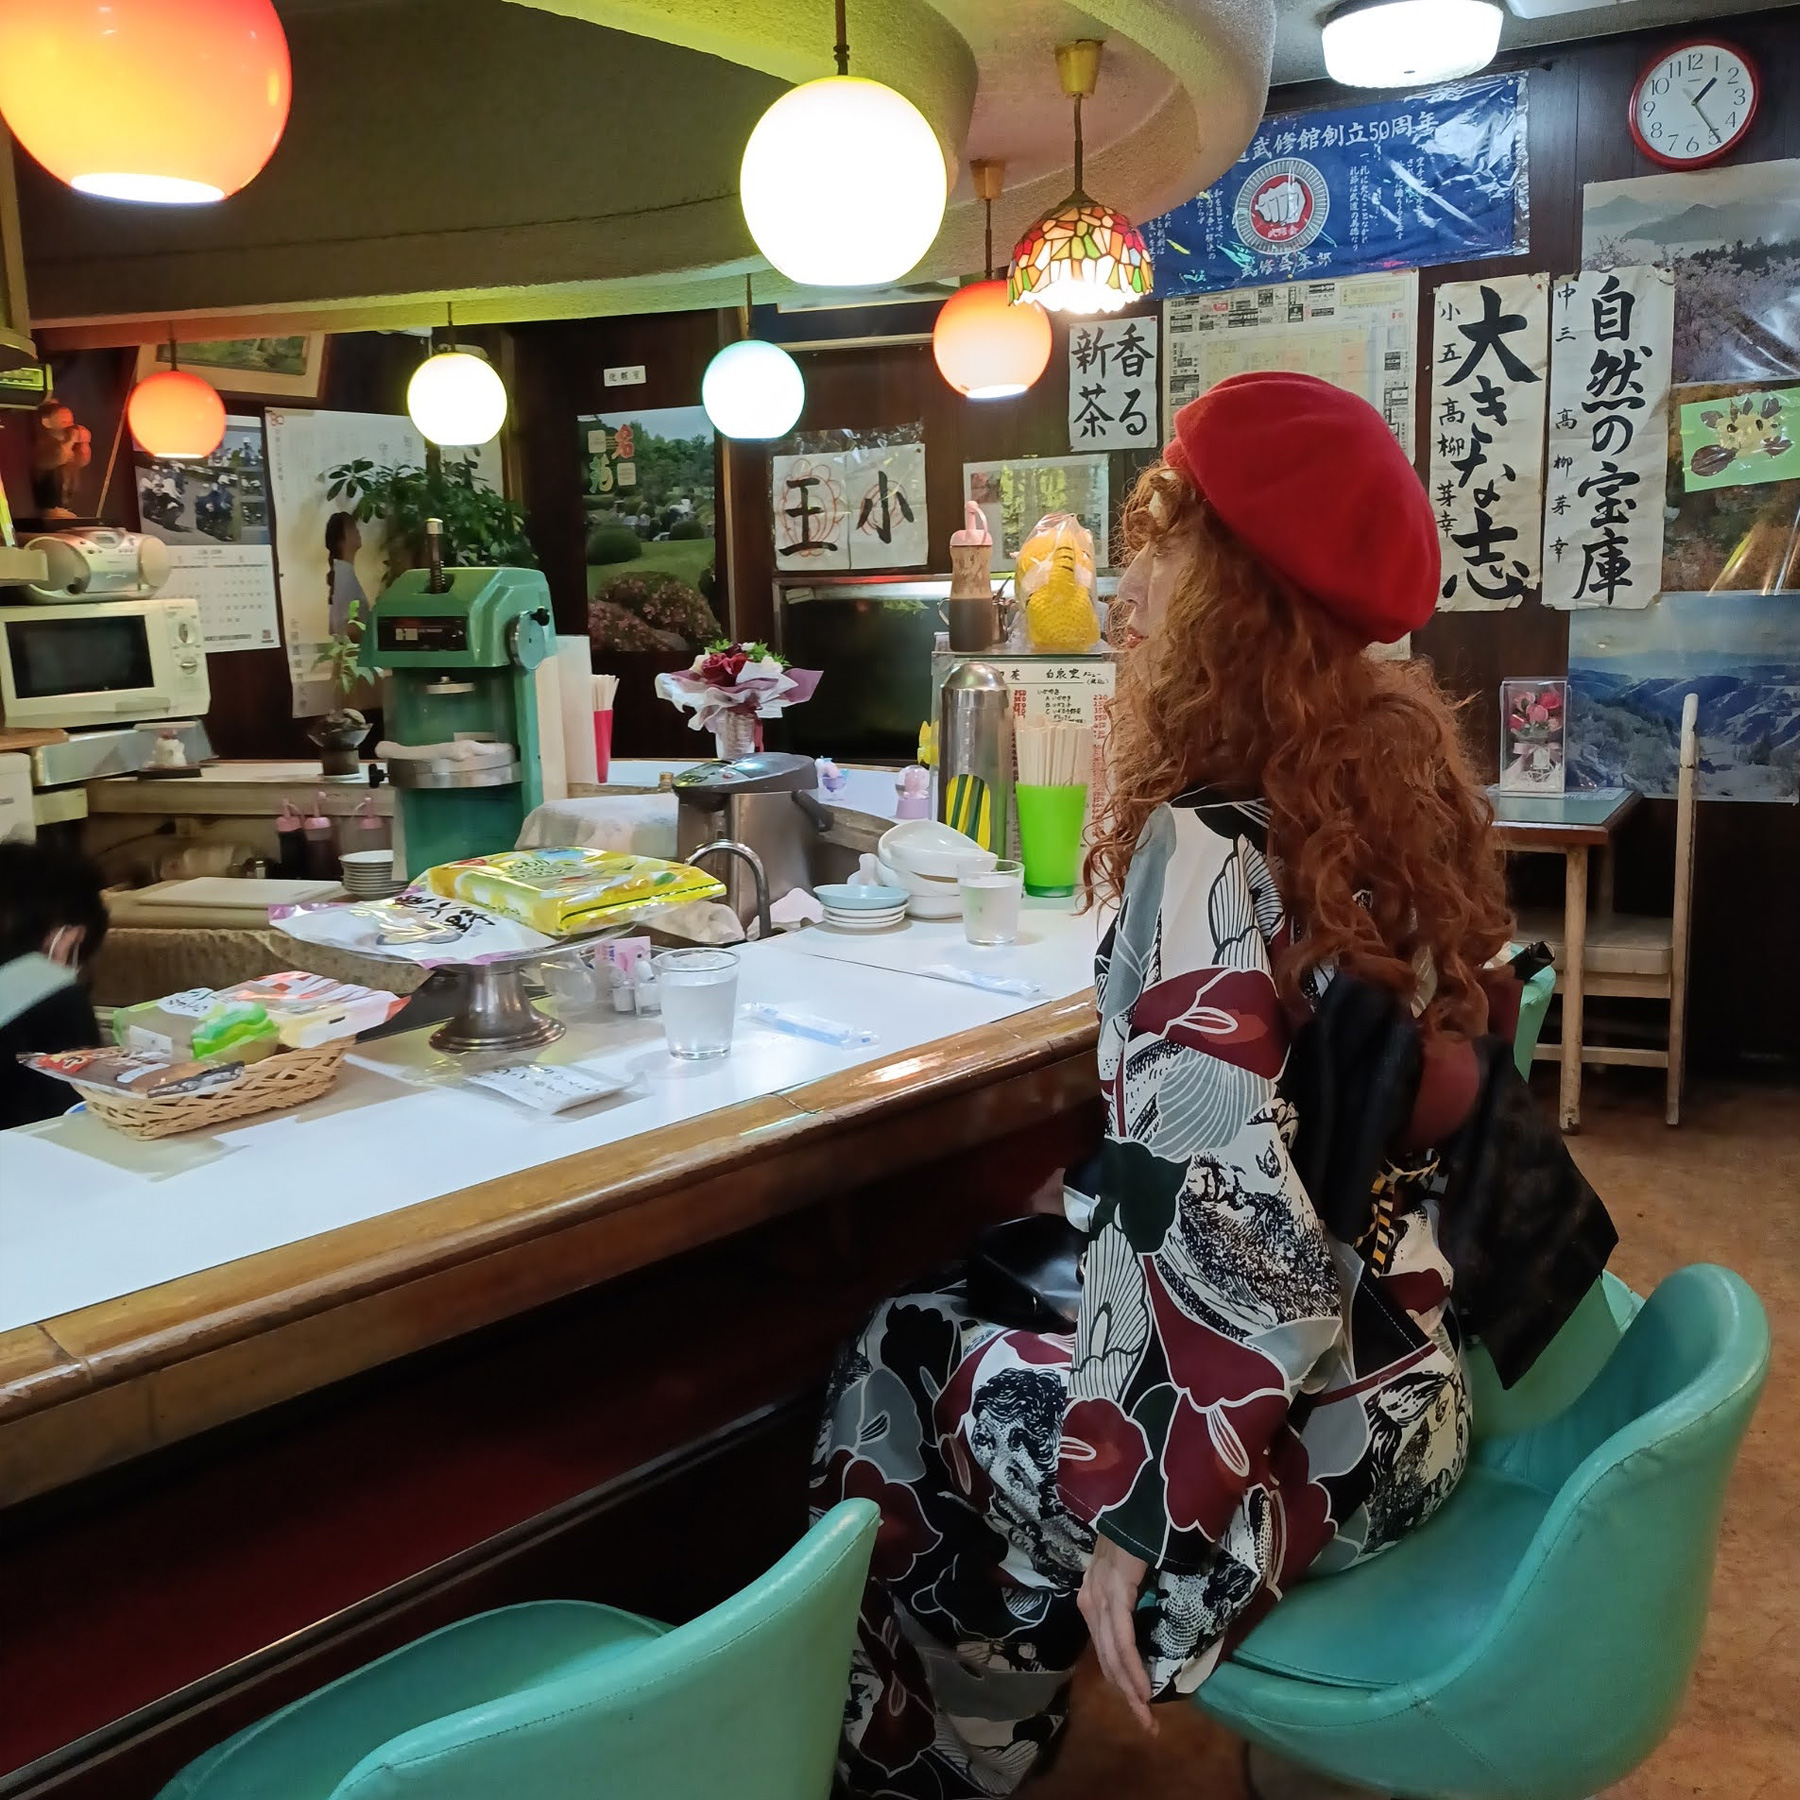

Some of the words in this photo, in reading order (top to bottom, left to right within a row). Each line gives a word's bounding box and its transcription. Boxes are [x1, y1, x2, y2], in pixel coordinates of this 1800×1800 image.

[1669, 60, 1682, 79] 11
[1687, 52, 1704, 71] 12
[1714, 55, 1719, 72] 1
[1727, 66, 1740, 85] 2
[1651, 77, 1670, 96] 10
[1733, 87, 1746, 106] 3
[1643, 100, 1656, 118] 9
[1724, 111, 1736, 128] 4
[1651, 122, 1663, 139] 8
[1708, 127, 1720, 146] 5
[1667, 134, 1679, 151] 7
[1686, 136, 1700, 153] 6
[1555, 283, 1577, 342] 中三
[1437, 302, 1462, 364] 小五
[1442, 285, 1543, 600] 大きな志
[1572, 276, 1653, 605] 自然の宝庫
[855, 470, 915, 544] 小
[778, 477, 839, 557] 王
